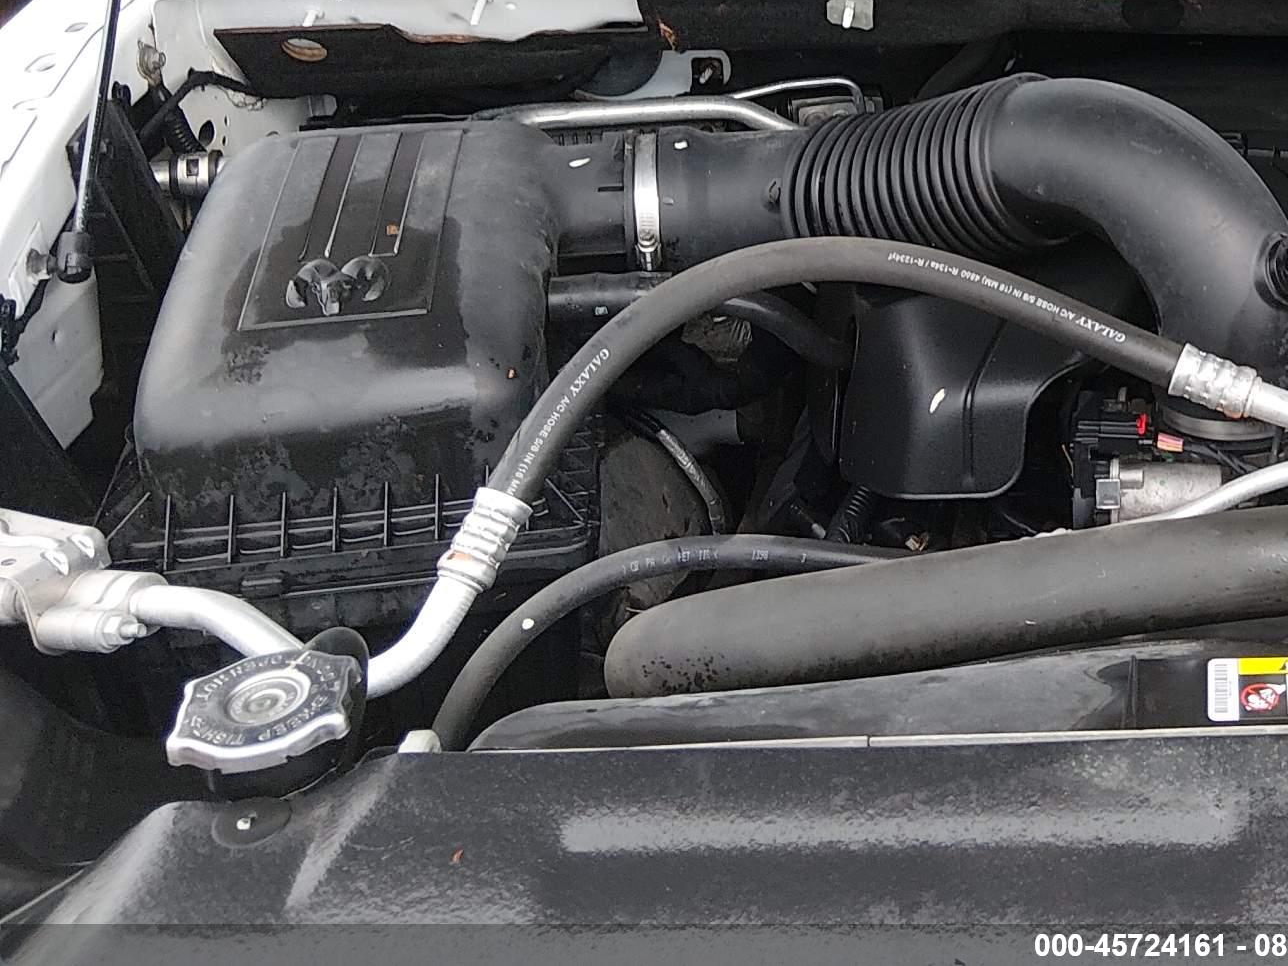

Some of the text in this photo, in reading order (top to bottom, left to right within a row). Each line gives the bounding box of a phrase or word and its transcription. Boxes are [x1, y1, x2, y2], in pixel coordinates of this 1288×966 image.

[930, 260, 959, 276] R-134a
[981, 275, 999, 290] MM)
[1012, 288, 1023, 298] IN
[1035, 297, 1060, 314] HOSE
[1060, 308, 1076, 321] A/C
[1075, 316, 1126, 343] GALAXY
[570, 347, 611, 397] GALAXY
[557, 395, 571, 413] A/C
[542, 411, 561, 439] HOSE
[523, 451, 536, 466] IN
